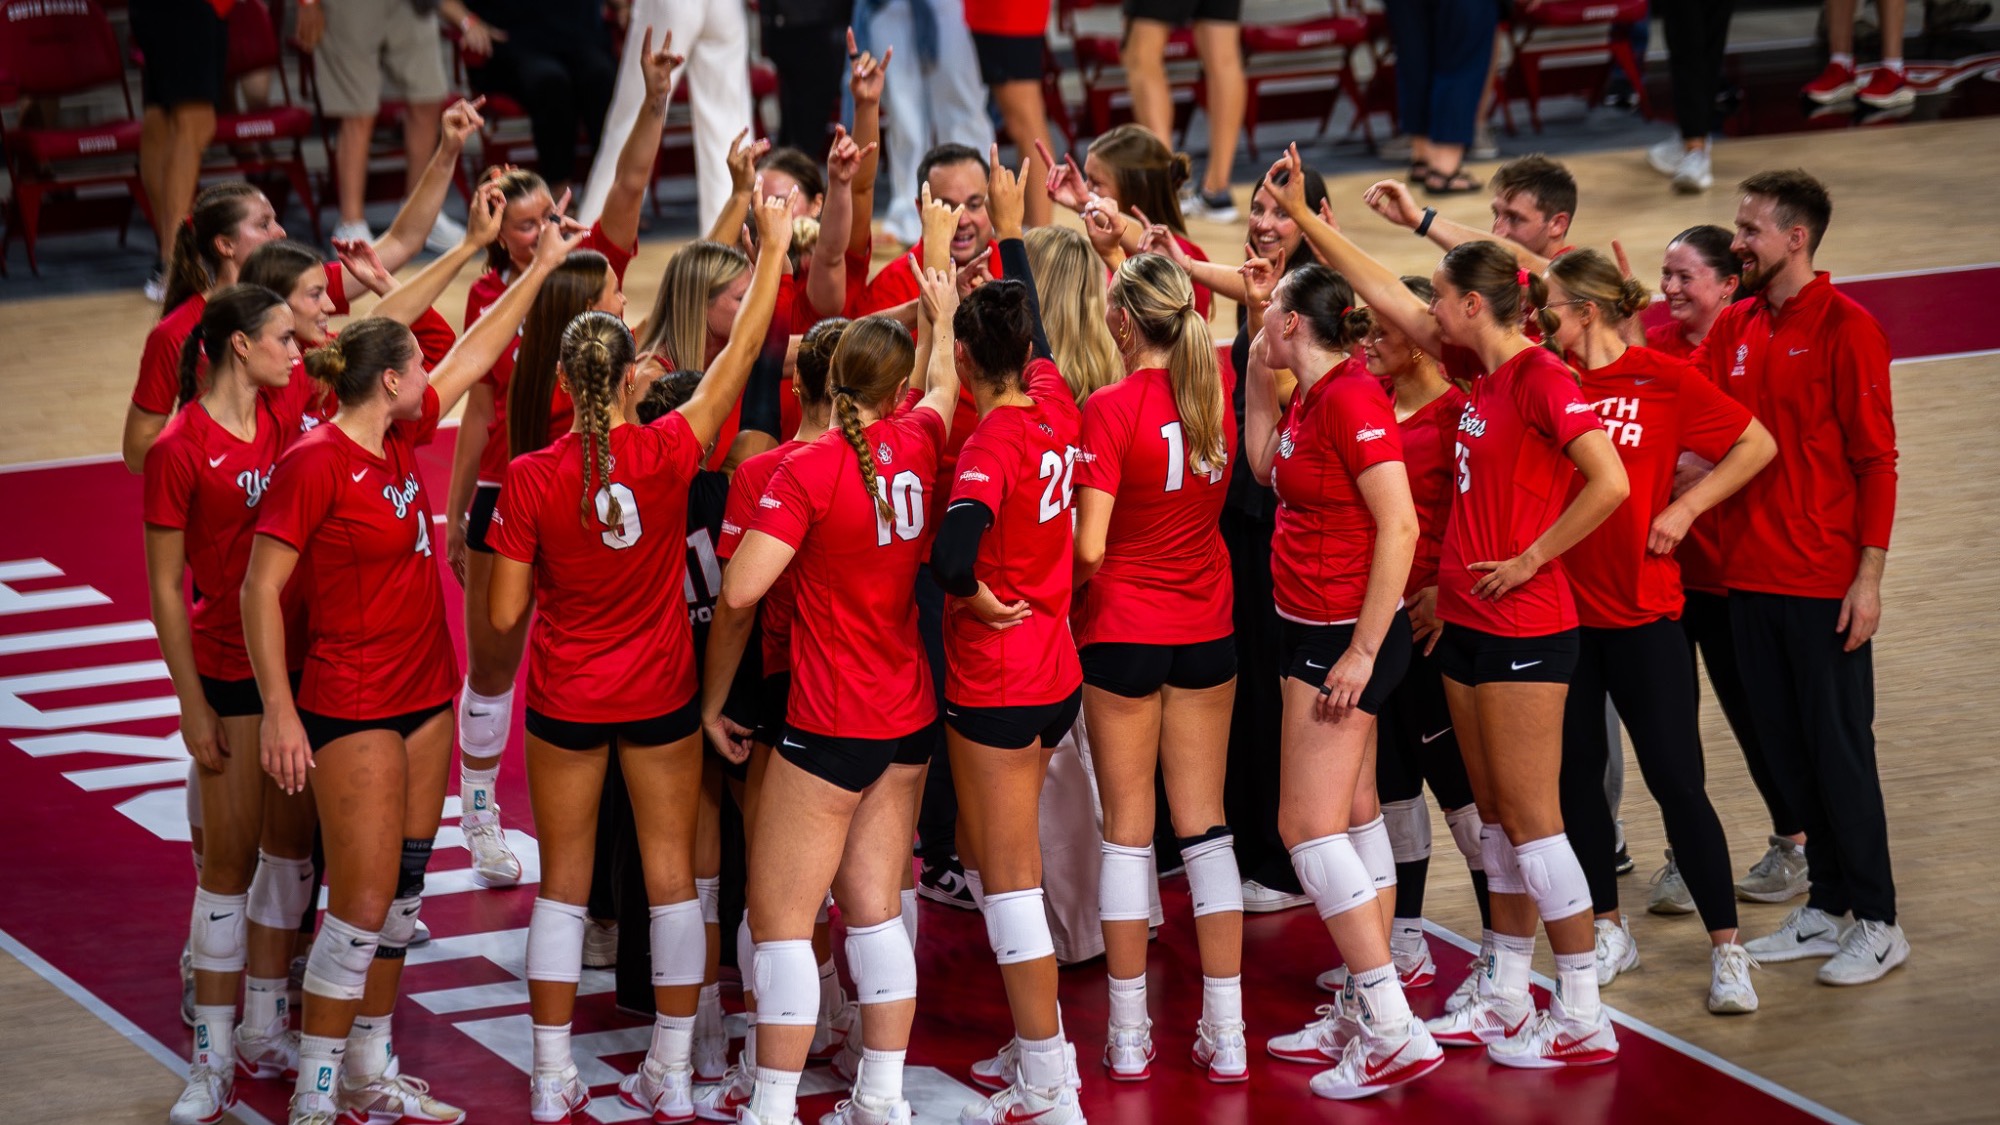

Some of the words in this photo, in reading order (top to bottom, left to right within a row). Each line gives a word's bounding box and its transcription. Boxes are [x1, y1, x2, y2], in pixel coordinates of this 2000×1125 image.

[414, 508, 432, 558] 4
[594, 482, 643, 550] 9
[873, 470, 925, 547] 10
